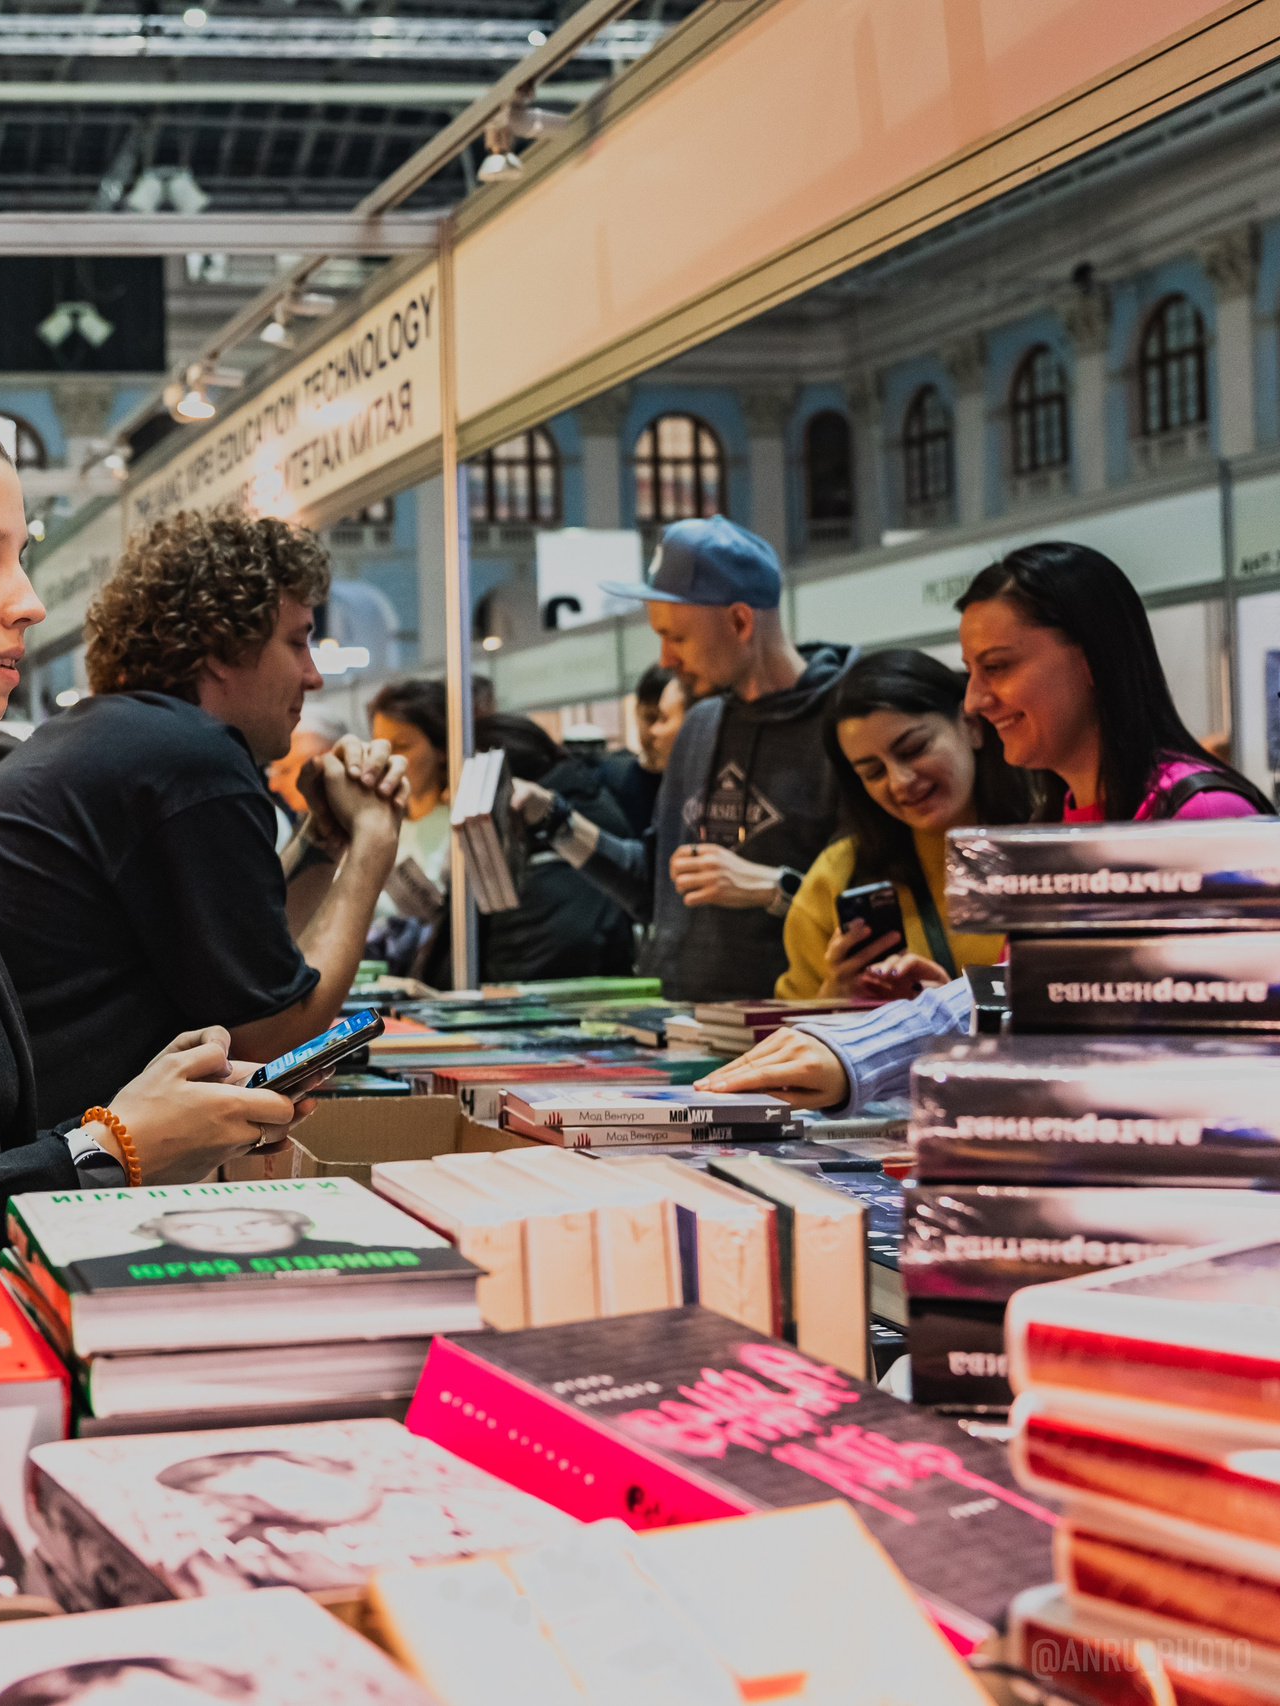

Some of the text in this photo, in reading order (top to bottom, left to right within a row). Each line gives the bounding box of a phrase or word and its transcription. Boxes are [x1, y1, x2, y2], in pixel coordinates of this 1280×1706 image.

[218, 388, 297, 475] EDUCATION
[304, 285, 435, 410] TECHNOLOGY
[348, 378, 414, 461] КИТАЯ
[1046, 977, 1269, 1003] альтернатива
[579, 1108, 713, 1123] Мод Вентура МОЙ МУЖ
[606, 1126, 733, 1142] Мод Вентура МОЙ МУЖ
[51, 1191, 133, 1204] ИГРА
